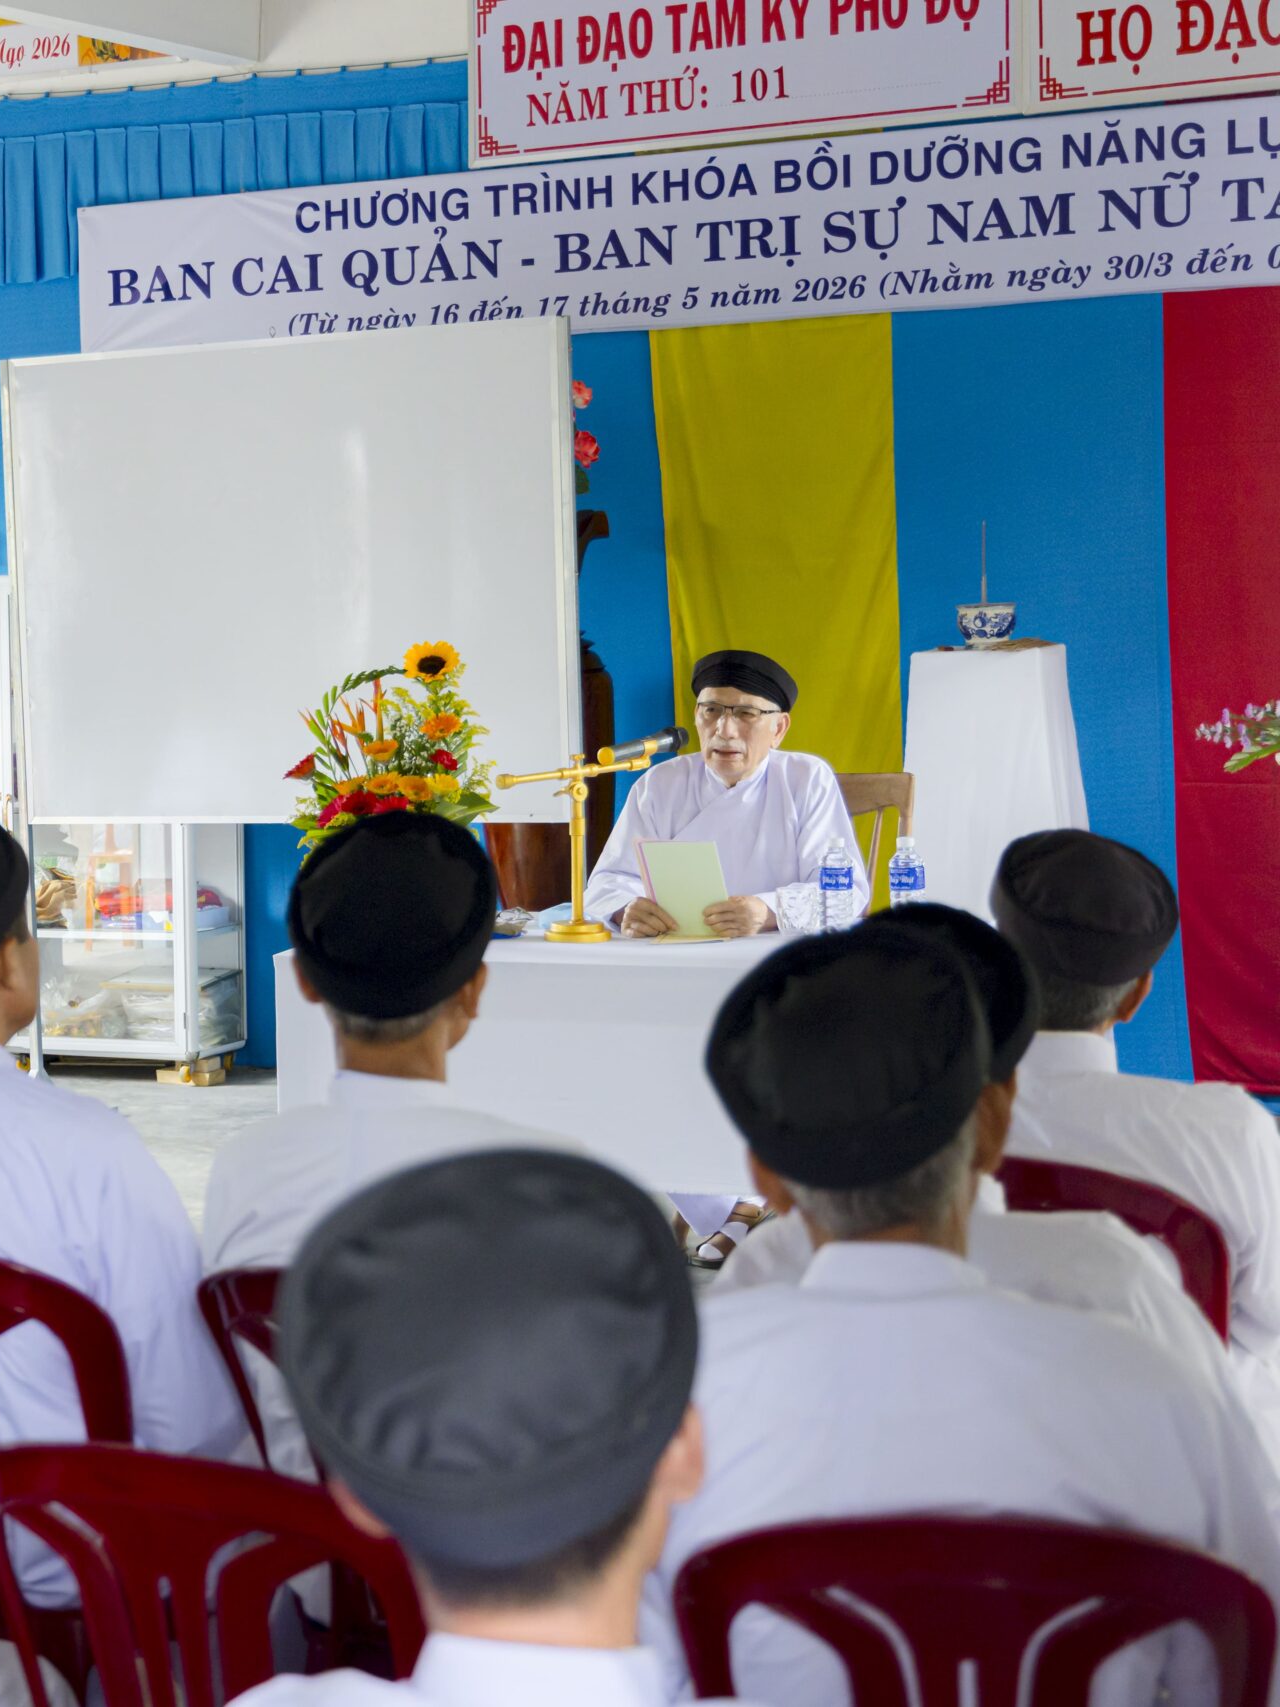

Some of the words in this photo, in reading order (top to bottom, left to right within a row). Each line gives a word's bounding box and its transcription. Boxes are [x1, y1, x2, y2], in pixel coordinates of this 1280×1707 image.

[31, 33, 71, 60] 2026
[502, 19, 564, 81] ĐẠI
[576, 9, 653, 73] ĐẠO
[665, 0, 746, 53] TAM
[1076, 4, 1153, 75] HỌ
[1176, 0, 1280, 64] ĐẠO
[526, 80, 608, 127] NĂM
[620, 66, 709, 117] THỨ:
[732, 65, 790, 104] 101
[295, 188, 470, 234] CHƯƠNG
[484, 172, 613, 218] TRÌNH
[631, 156, 757, 206] KHÓA
[774, 141, 851, 194] BỒI
[870, 134, 1042, 186] DƯỠNG
[1062, 119, 1206, 169] NĂNG
[107, 261, 216, 307] BAN
[231, 252, 324, 297] CAI
[341, 226, 503, 297] QUẢN
[521, 257, 535, 267] -
[554, 224, 678, 274] BAN
[696, 214, 801, 268] TRỊ
[823, 195, 908, 261] SỰ
[927, 192, 1076, 245] NAM
[1098, 170, 1200, 233] NỮ
[288, 312, 338, 337] (Từ
[430, 303, 460, 326] 16
[469, 295, 524, 322] đến
[539, 295, 570, 318] 17
[578, 289, 671, 320] tháng
[682, 286, 699, 311] 5
[710, 281, 781, 308] năm
[792, 274, 867, 303] 2026
[879, 262, 995, 301] (Nhằm
[1007, 259, 1091, 291] ngày
[1104, 251, 1173, 281] 30/3
[1186, 243, 1253, 275] đến
